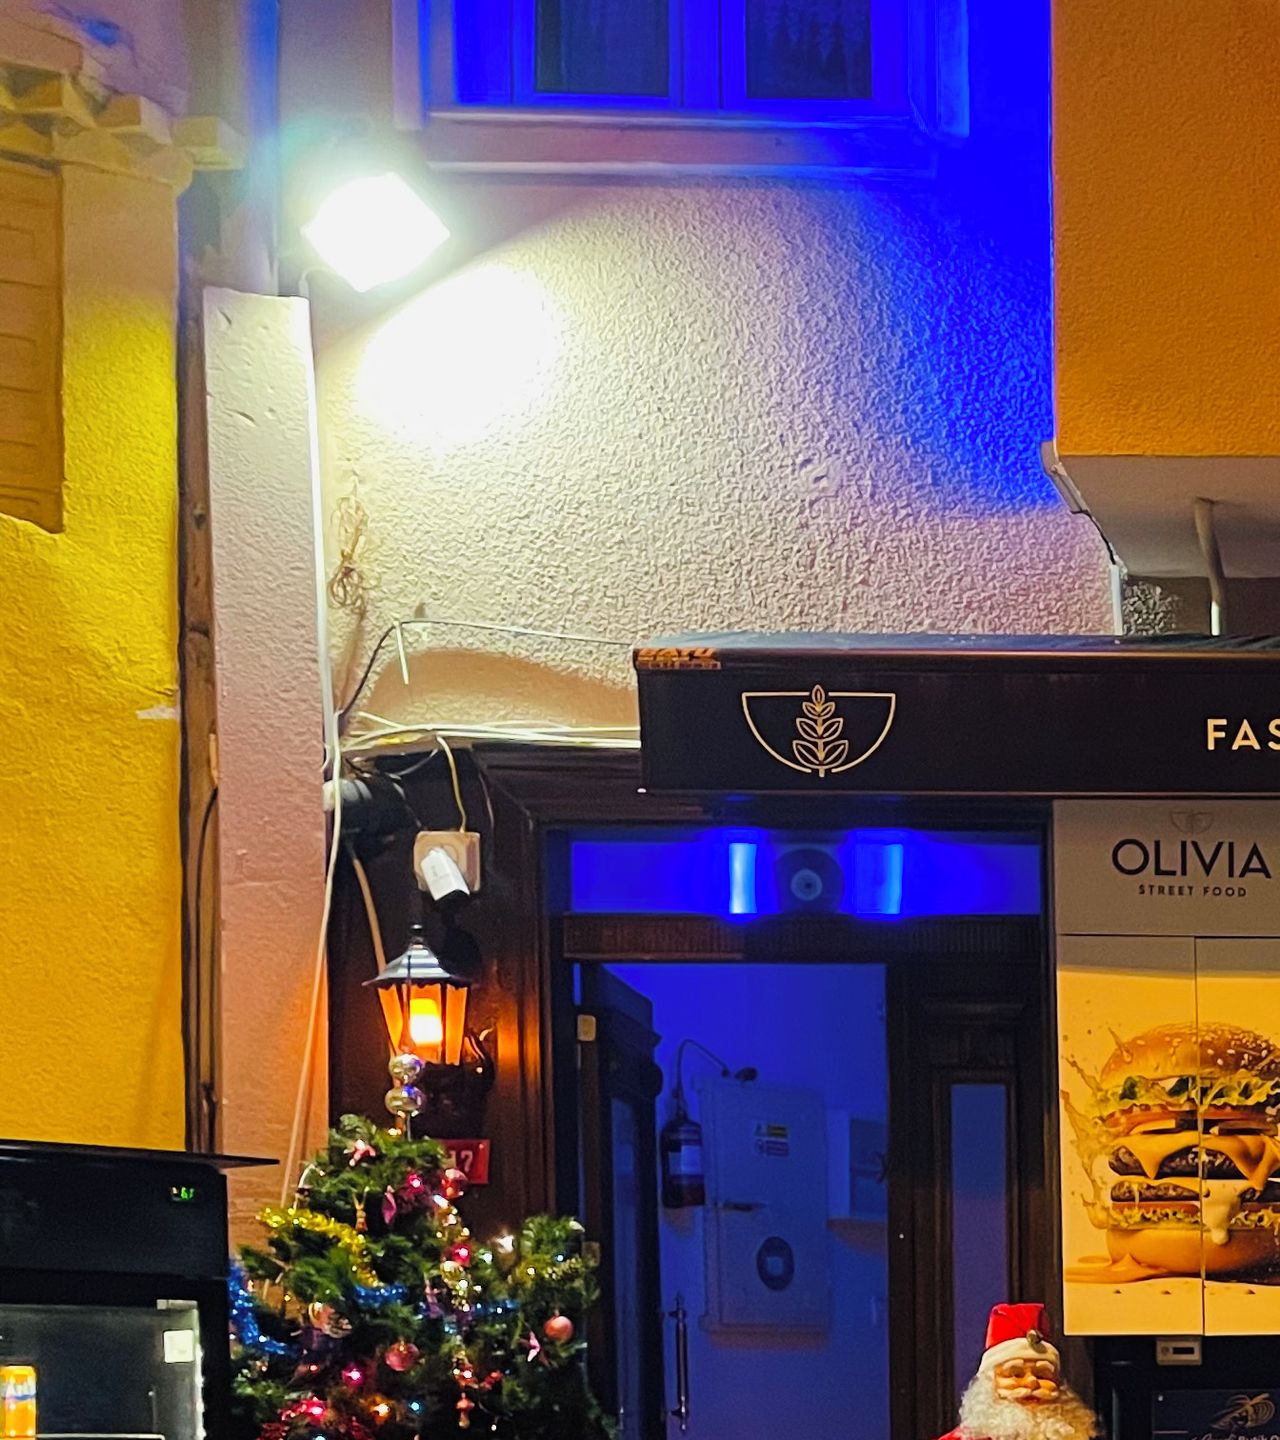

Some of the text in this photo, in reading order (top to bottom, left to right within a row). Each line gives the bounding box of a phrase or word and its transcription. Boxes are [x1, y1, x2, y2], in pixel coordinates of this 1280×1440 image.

[1112, 838, 1272, 879] OLIVIA
[1138, 884, 1247, 898] STREET FOOD
